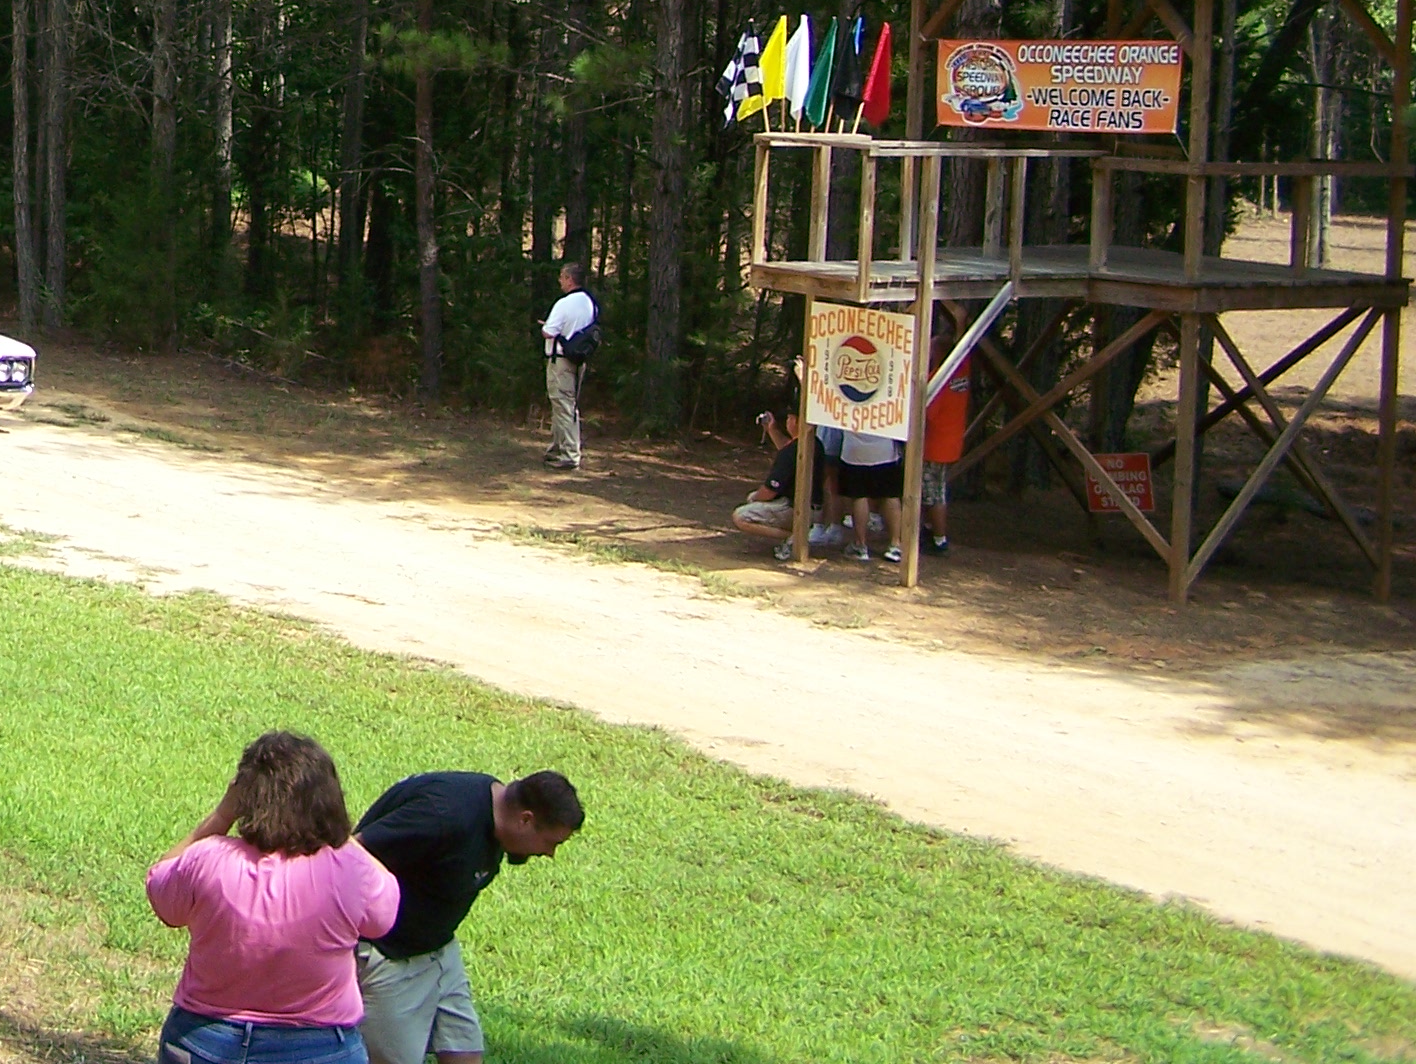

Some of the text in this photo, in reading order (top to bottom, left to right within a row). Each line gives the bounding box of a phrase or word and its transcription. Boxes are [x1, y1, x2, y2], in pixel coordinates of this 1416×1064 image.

[1017, 44, 1115, 63] OCCONEECHEE
[1118, 45, 1179, 65] ORANGE
[1050, 64, 1143, 85] SPEEDWAY
[1047, 109, 1144, 130] RACE FANS
[810, 308, 912, 354] OCCONEECHEE
[1106, 459, 1124, 469] NO
